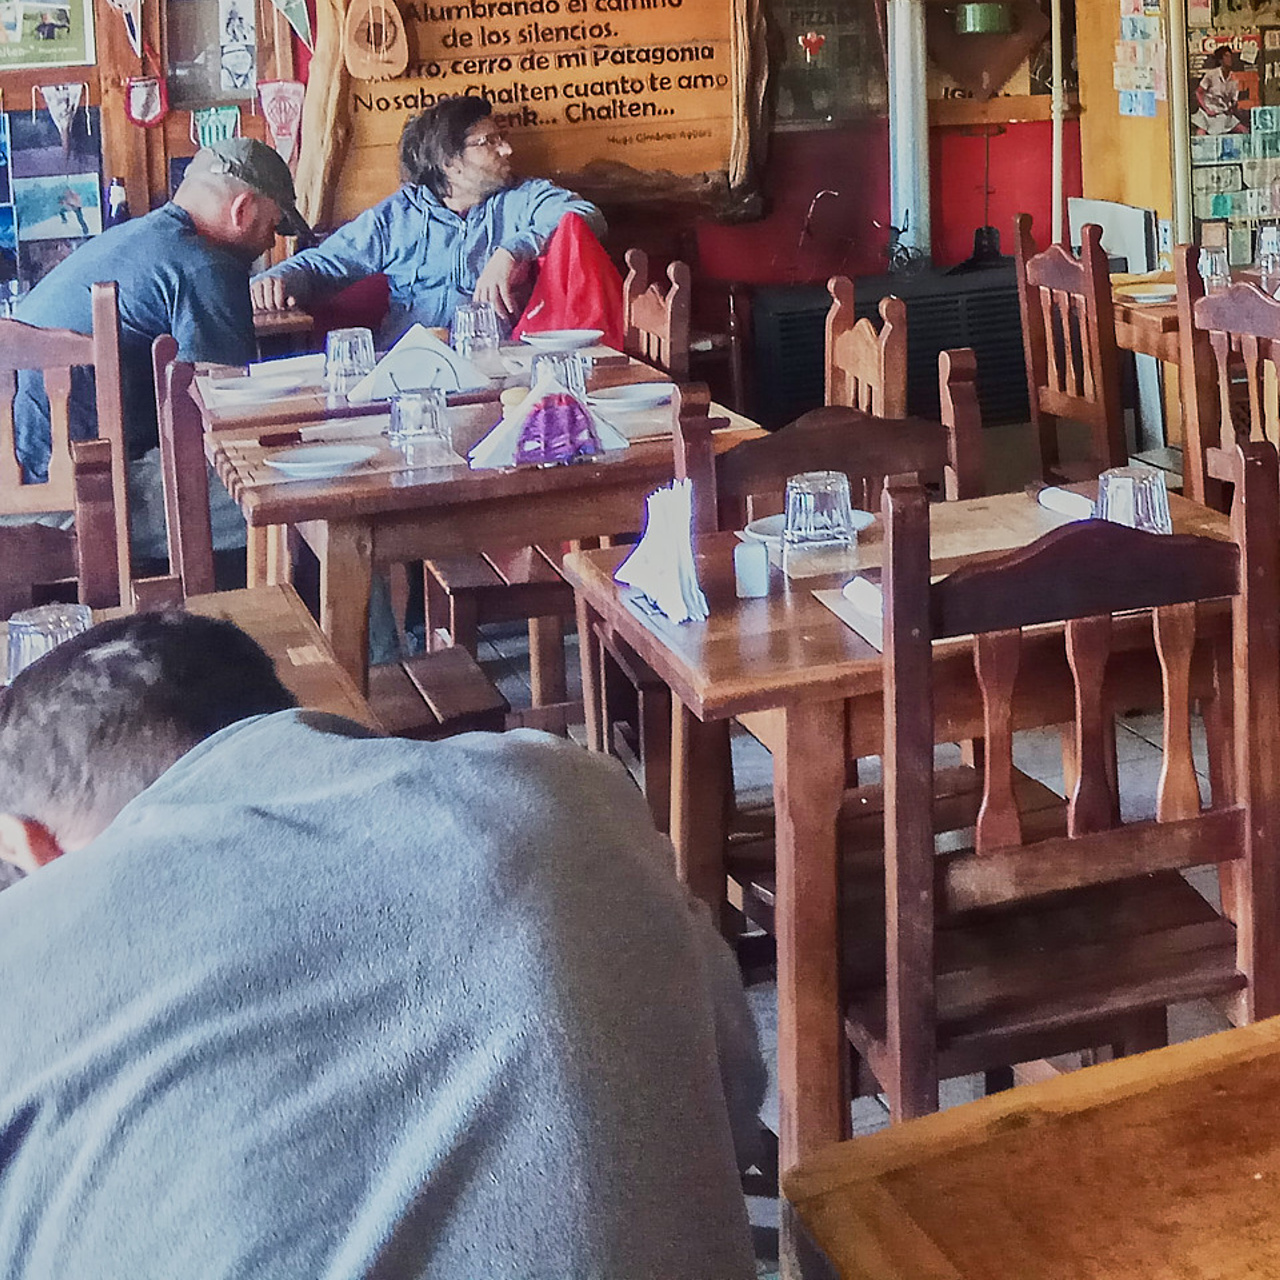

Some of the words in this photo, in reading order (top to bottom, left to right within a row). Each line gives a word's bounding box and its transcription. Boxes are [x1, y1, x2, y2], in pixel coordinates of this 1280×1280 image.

[442, 26, 473, 49] de
[480, 24, 511, 47] los
[450, 53, 513, 76] cerro
[519, 48, 550, 71] de
[556, 46, 588, 69] mi
[593, 43, 715, 71] Patagonia
[463, 81, 558, 105] Chalten
[562, 77, 645, 99] cuanto
[648, 74, 672, 93] te
[677, 72, 729, 91] amo
